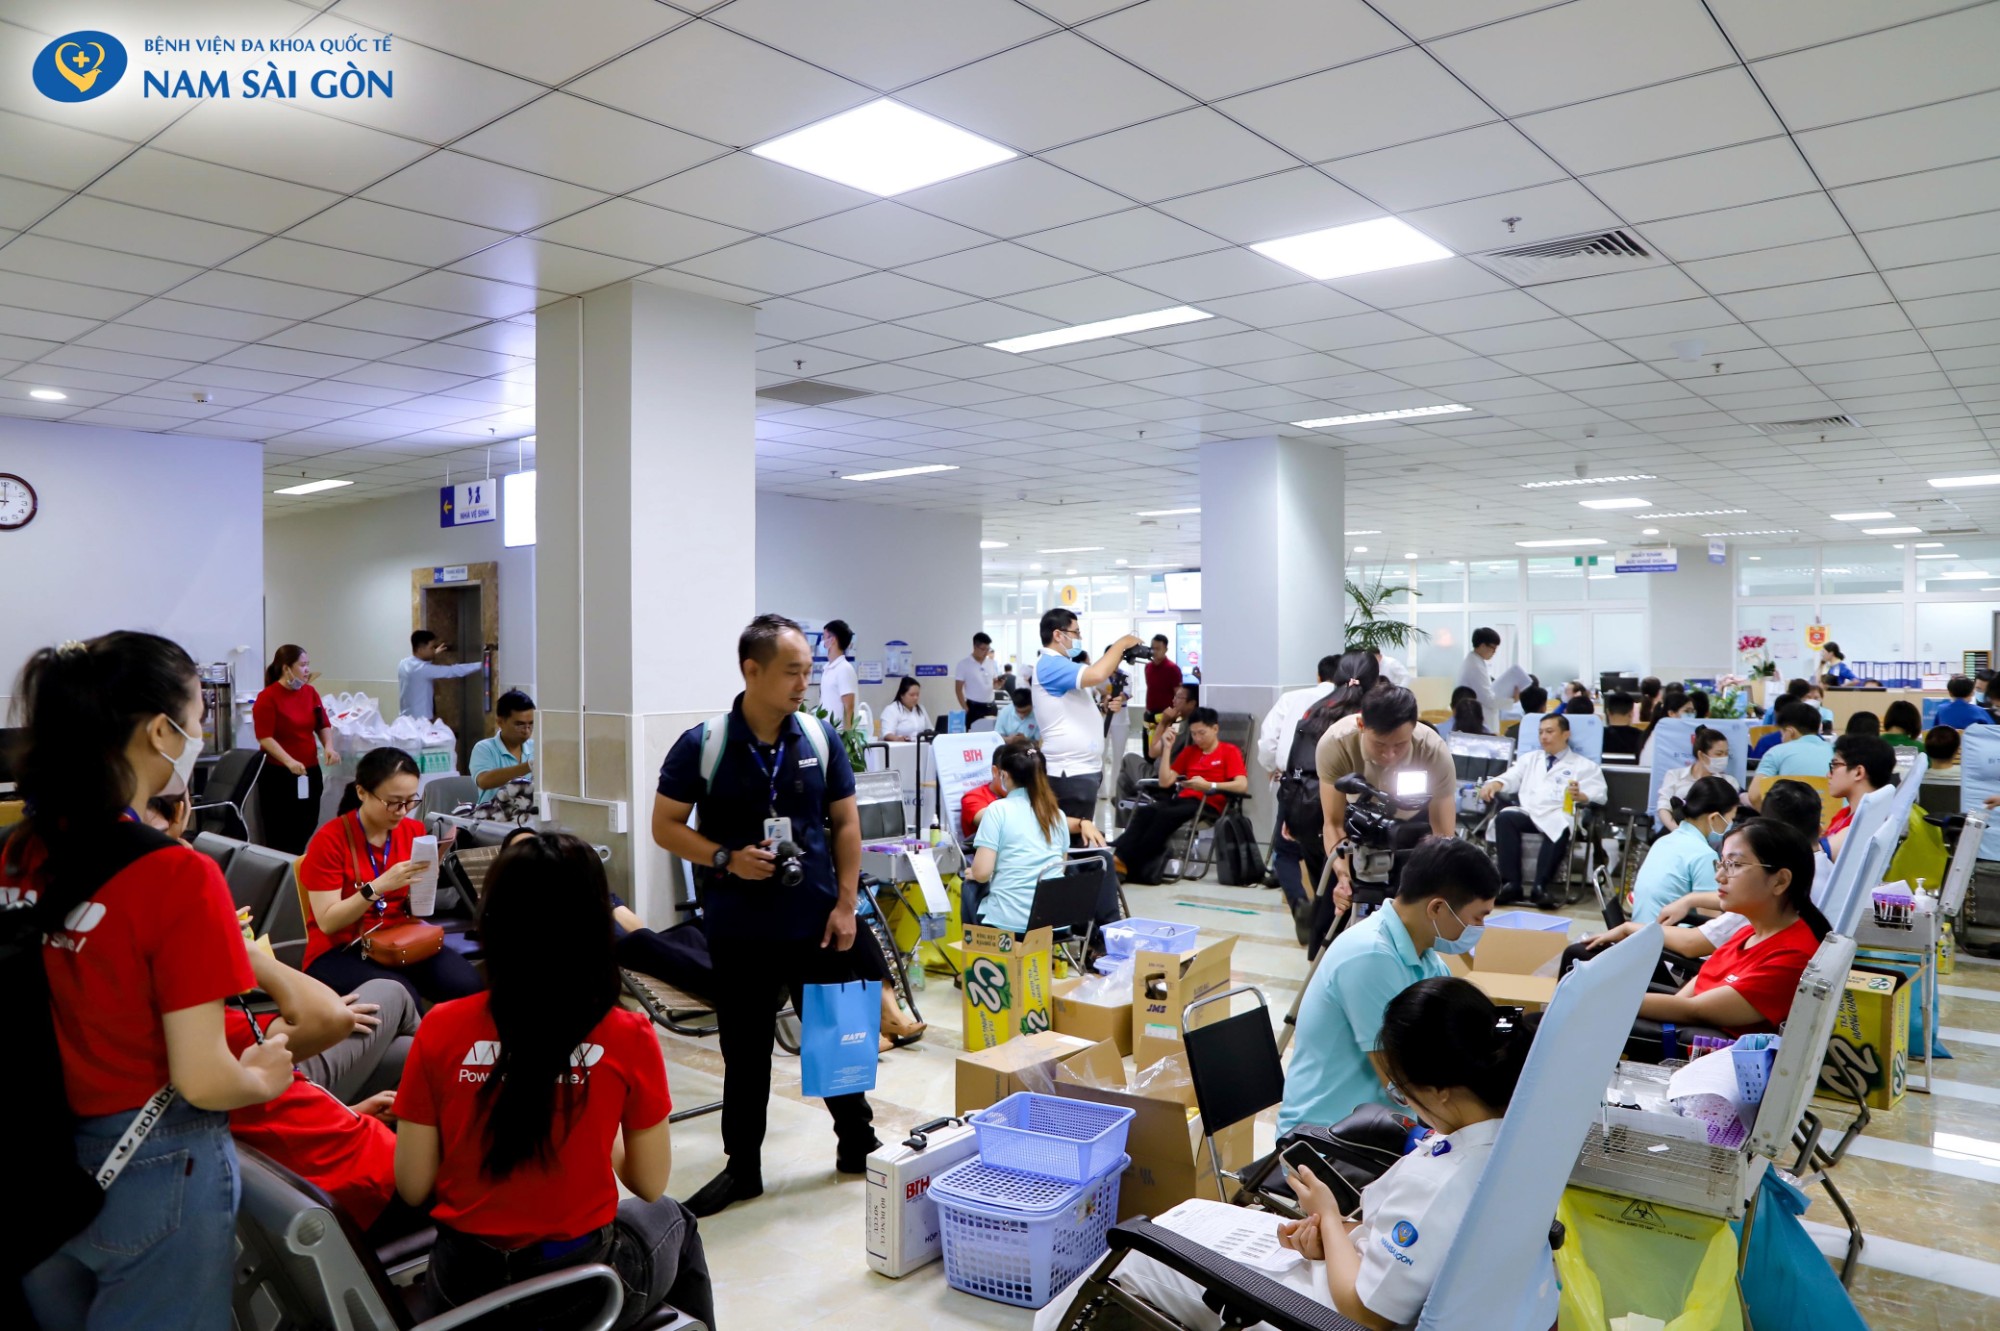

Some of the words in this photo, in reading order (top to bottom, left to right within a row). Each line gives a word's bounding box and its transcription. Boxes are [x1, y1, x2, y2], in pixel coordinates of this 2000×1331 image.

[1066, 589, 1071, 601] 1
[963, 749, 983, 762] BTH
[998, 934, 1012, 951] C2
[967, 957, 1005, 1014] C2
[1868, 977, 1891, 990] C2
[1146, 1003, 1167, 1014] JMS
[1821, 1037, 1880, 1099] C2
[1893, 1050, 1905, 1096] C2
[906, 1175, 930, 1200] BTH
